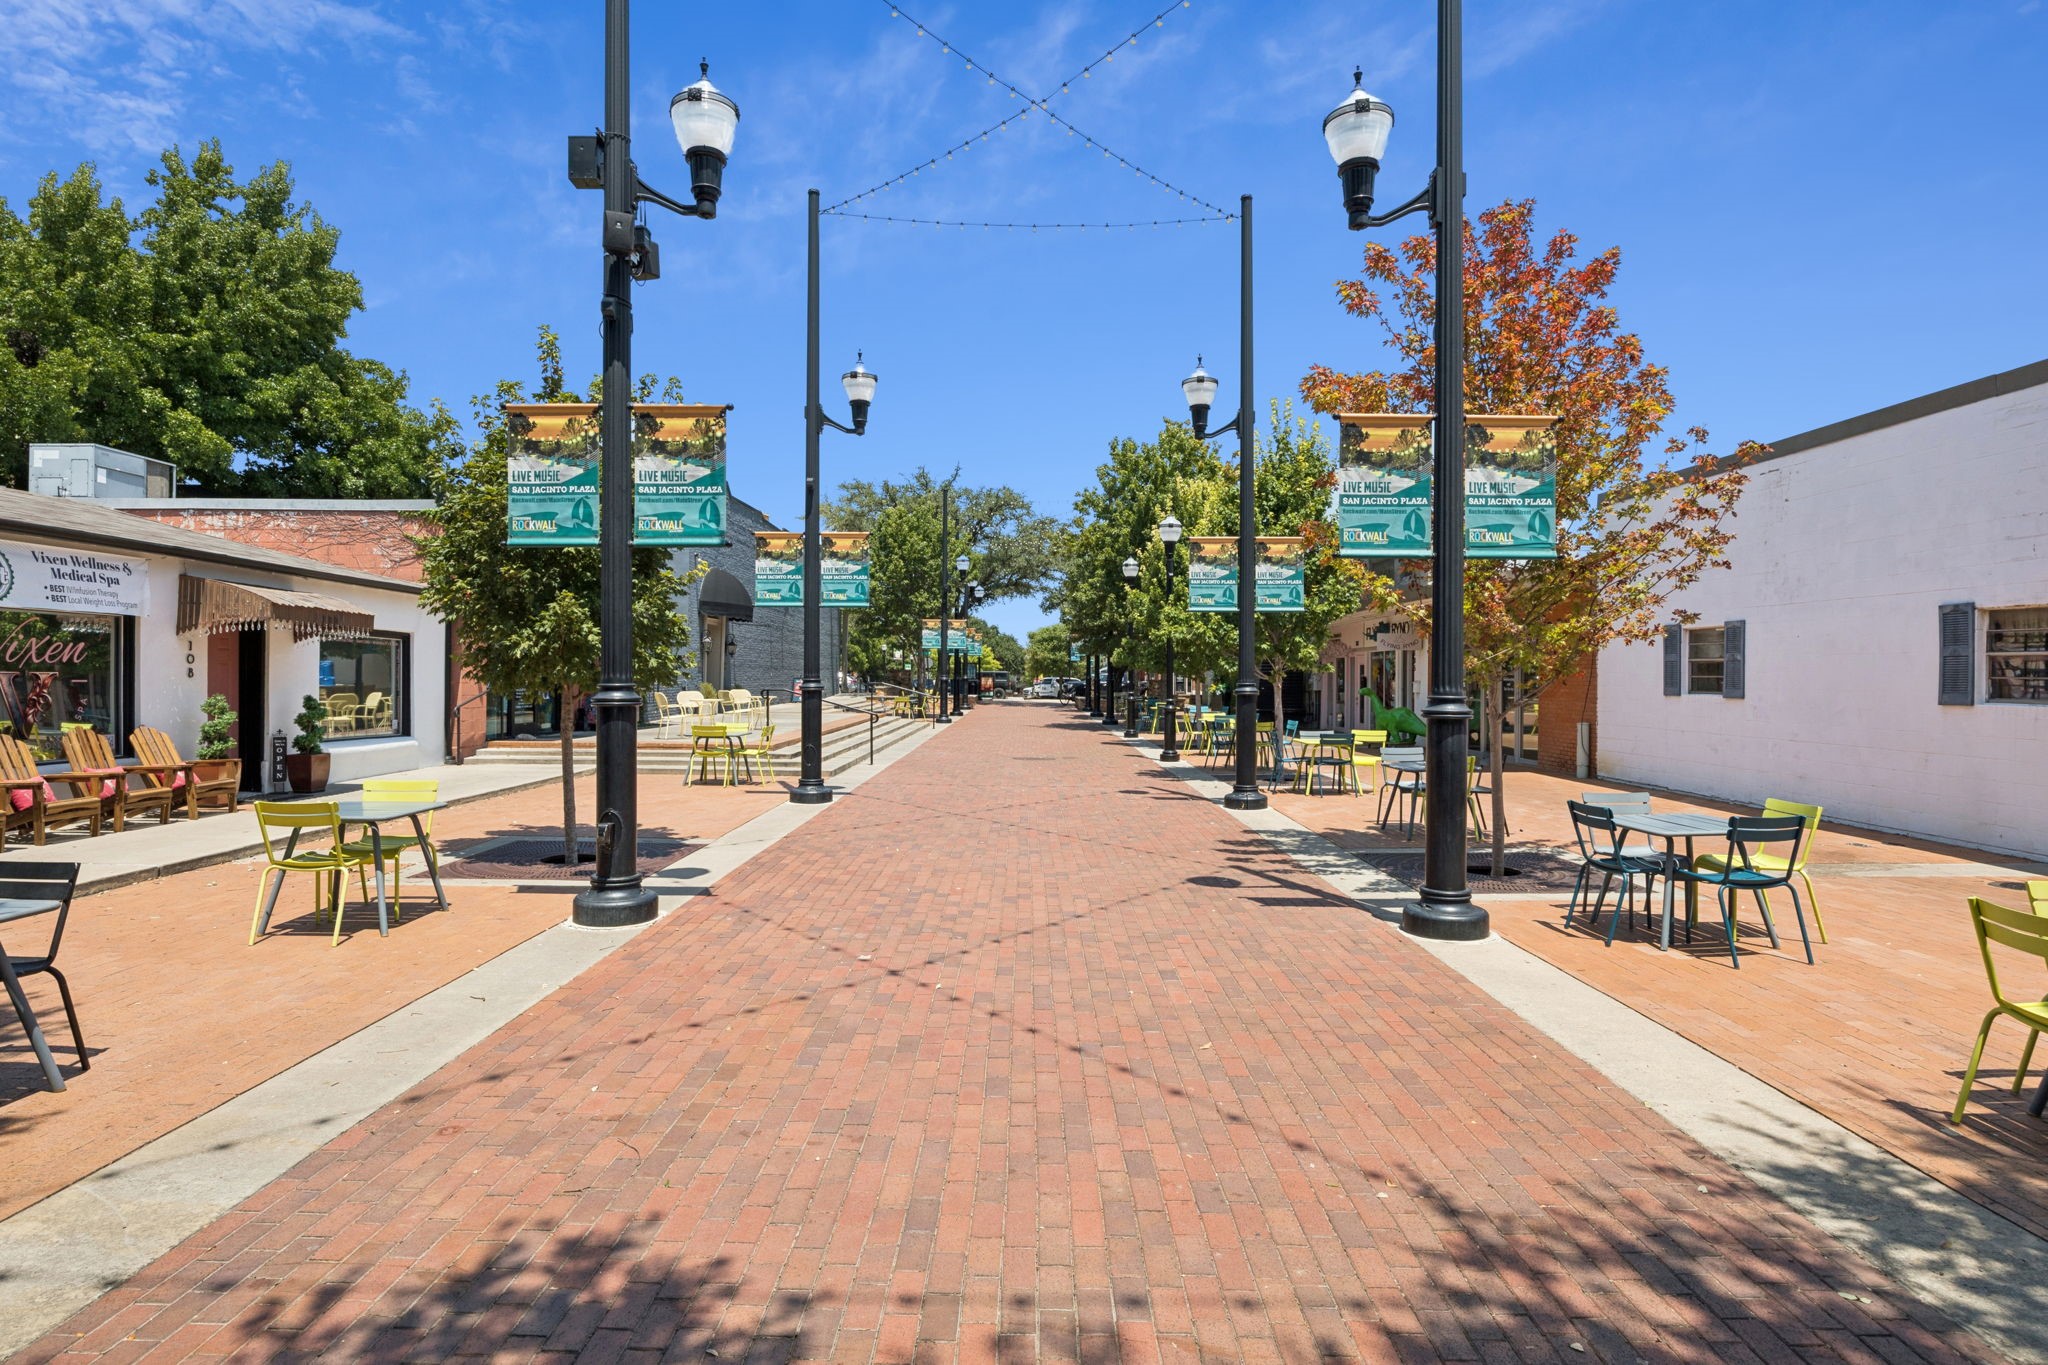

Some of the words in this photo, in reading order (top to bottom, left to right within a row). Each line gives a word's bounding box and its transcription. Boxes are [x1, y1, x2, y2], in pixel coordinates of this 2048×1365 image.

[512, 470, 532, 482] LIVE
[534, 470, 560, 482] MUSIC
[639, 470, 658, 482] LIVE
[661, 470, 687, 482] MUSIC
[512, 486, 530, 494] SAN
[532, 486, 568, 494] JACINTO
[638, 486, 656, 494] SAN
[659, 486, 694, 494] JACINTO
[1343, 481, 1362, 493] LIVE
[1364, 481, 1392, 493] MUSIC
[1468, 481, 1488, 494] LIVE
[1490, 482, 1516, 494] MUSIC
[1342, 497, 1360, 505] SAN
[1362, 497, 1398, 506] JACINTO
[1400, 497, 1428, 505] PLAZA
[1488, 498, 1523, 506] JACINTO
[1524, 498, 1552, 506] PLAZA
[512, 519, 557, 530] ROCKWALL
[638, 519, 684, 530] ROCKWALL
[1343, 531, 1389, 542] ROCKWALL
[1469, 532, 1514, 543] ROCKWALL
[31, 550, 68, 566] Vixen
[70, 555, 120, 572] Wellness
[122, 562, 132, 576] &
[51, 568, 97, 583] Medical
[99, 572, 120, 587] Spa
[50, 585, 65, 593] BEST
[97, 588, 119, 599] Therapy
[51, 595, 67, 603] BEST
[68, 596, 82, 604] Local
[83, 598, 104, 608] Weight
[116, 601, 138, 610] Program
[186, 640, 195, 678] 108
